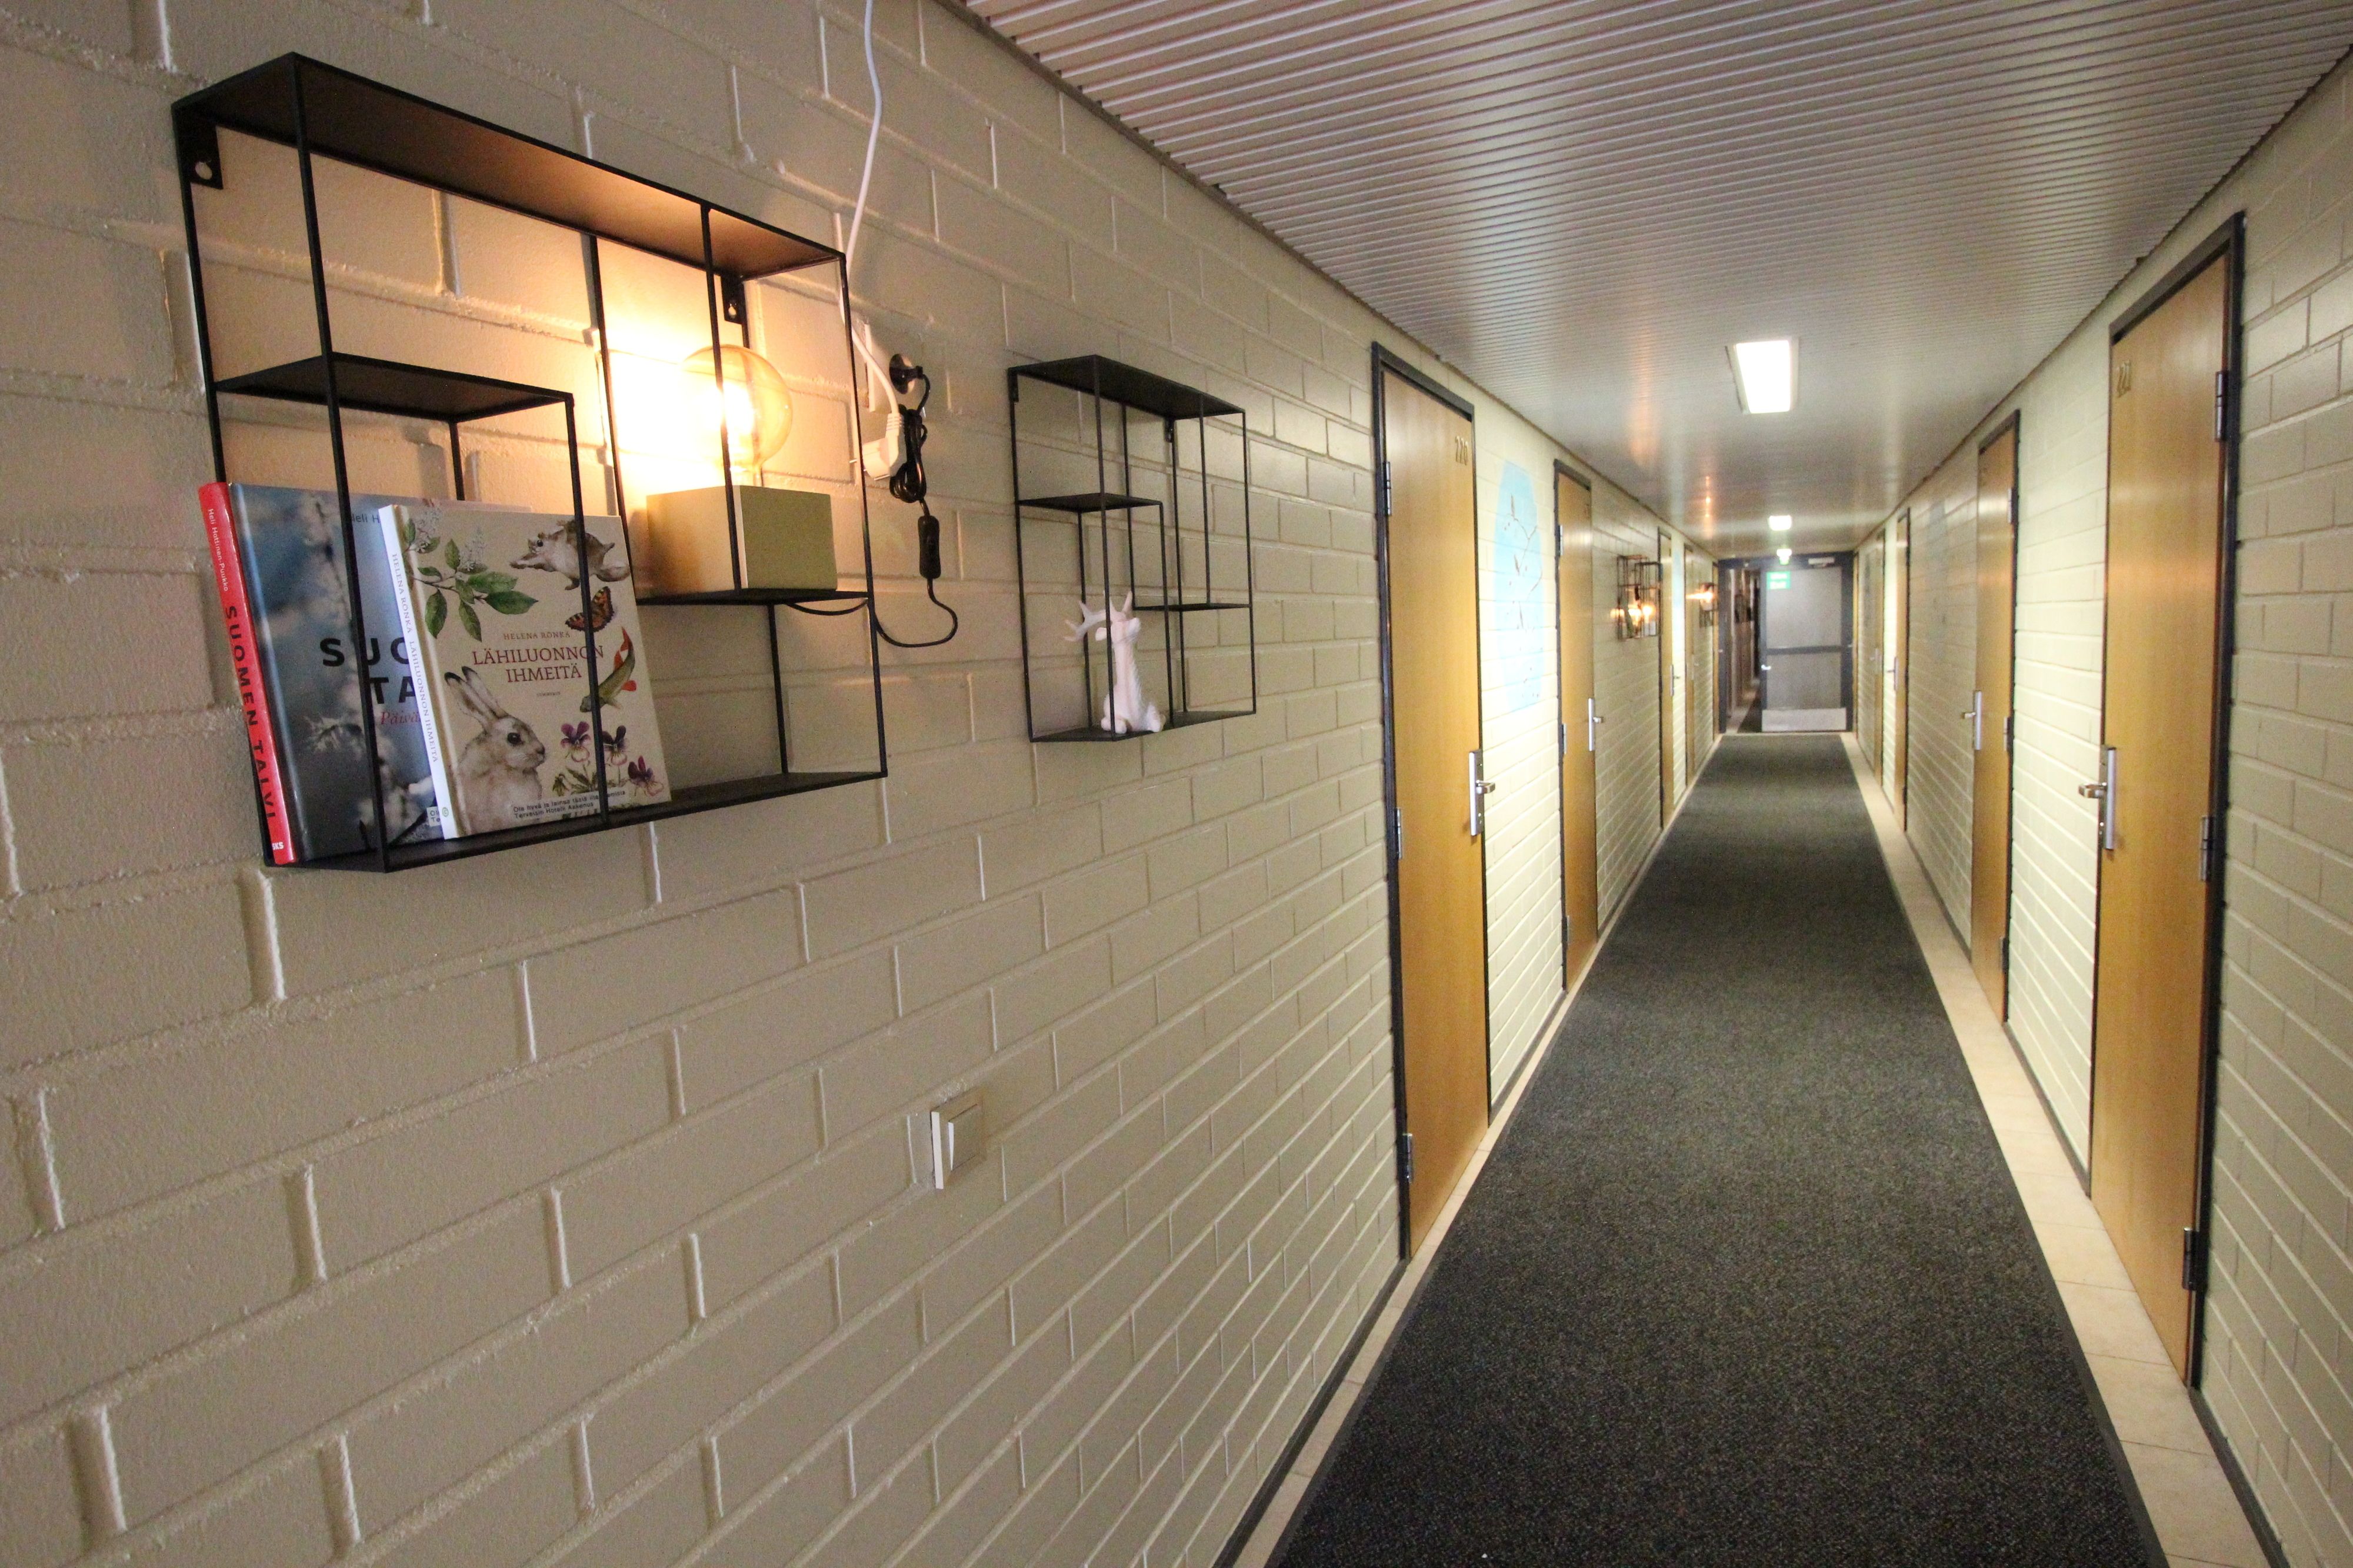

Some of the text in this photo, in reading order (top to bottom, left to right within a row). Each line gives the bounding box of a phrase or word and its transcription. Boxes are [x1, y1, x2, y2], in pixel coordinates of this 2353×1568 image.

[1455, 436, 1469, 466] 220
[208, 508, 216, 525] Heli
[392, 553, 405, 594] HELENA
[504, 632, 538, 640] HELENA
[319, 637, 409, 666] SUO
[472, 645, 604, 665] LÄHILUONNON
[506, 663, 582, 682] IHMEITÄ
[225, 605, 276, 818] SUOMEN TALVI
[381, 710, 422, 725] Päivä
[515, 809, 544, 819] Terveisin
[527, 802, 542, 811] hyvä
